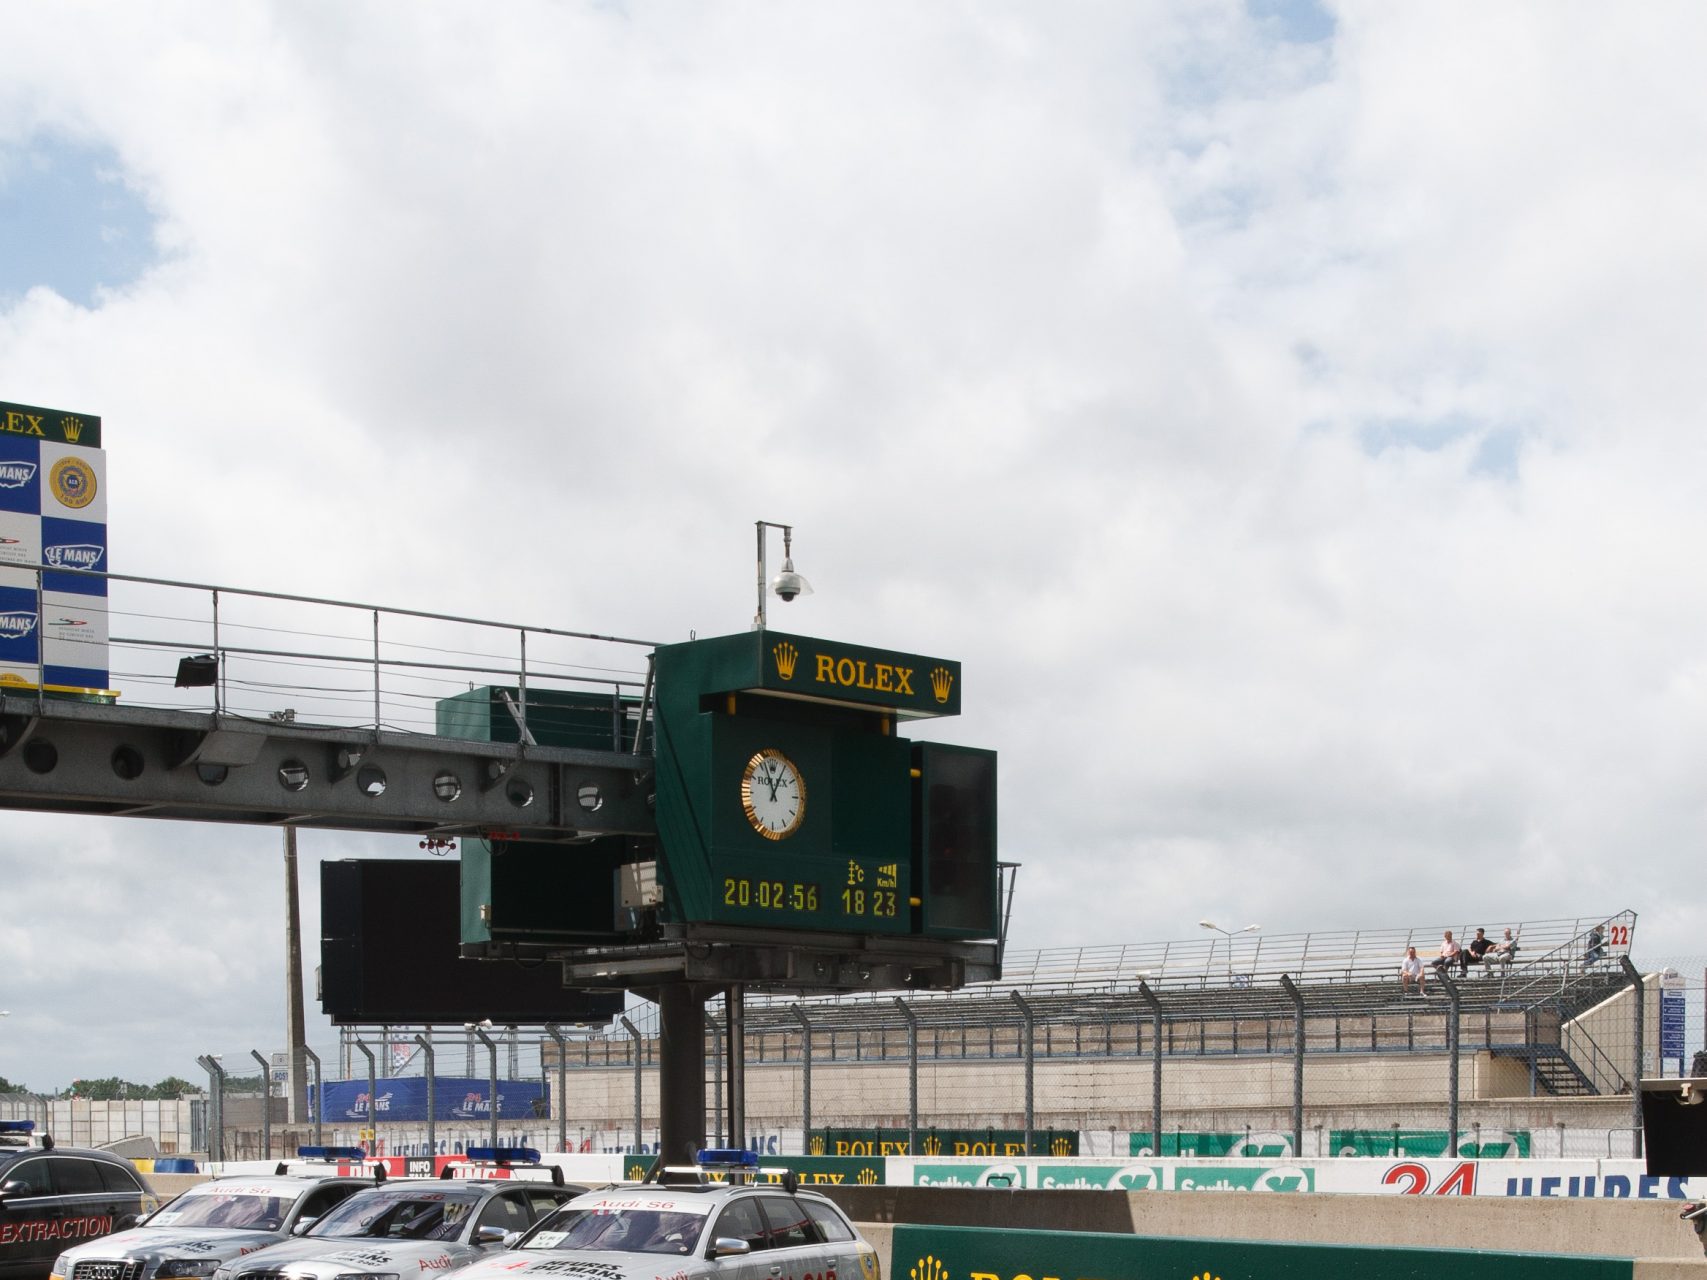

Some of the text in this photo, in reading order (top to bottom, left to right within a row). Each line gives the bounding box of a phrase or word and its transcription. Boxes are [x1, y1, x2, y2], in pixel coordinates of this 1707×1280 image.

[49, 547, 62, 561] LE
[64, 549, 96, 564] MANS
[815, 654, 914, 696] ROLEX
[877, 877, 895, 888] Km/h
[725, 878, 817, 911] 20:02:56
[842, 888, 896, 917] 18 23
[1611, 926, 1628, 945] 22
[354, 1103, 364, 1112] LE
[462, 1102, 501, 1113] LE MAS
[409, 1161, 431, 1173] INFO
[592, 1200, 676, 1209] Audi S6
[0, 1216, 113, 1244] EXTRACTION
[418, 1254, 453, 1272] Audi
[544, 1260, 622, 1271] HEURES
[563, 1266, 627, 1280] MANS
